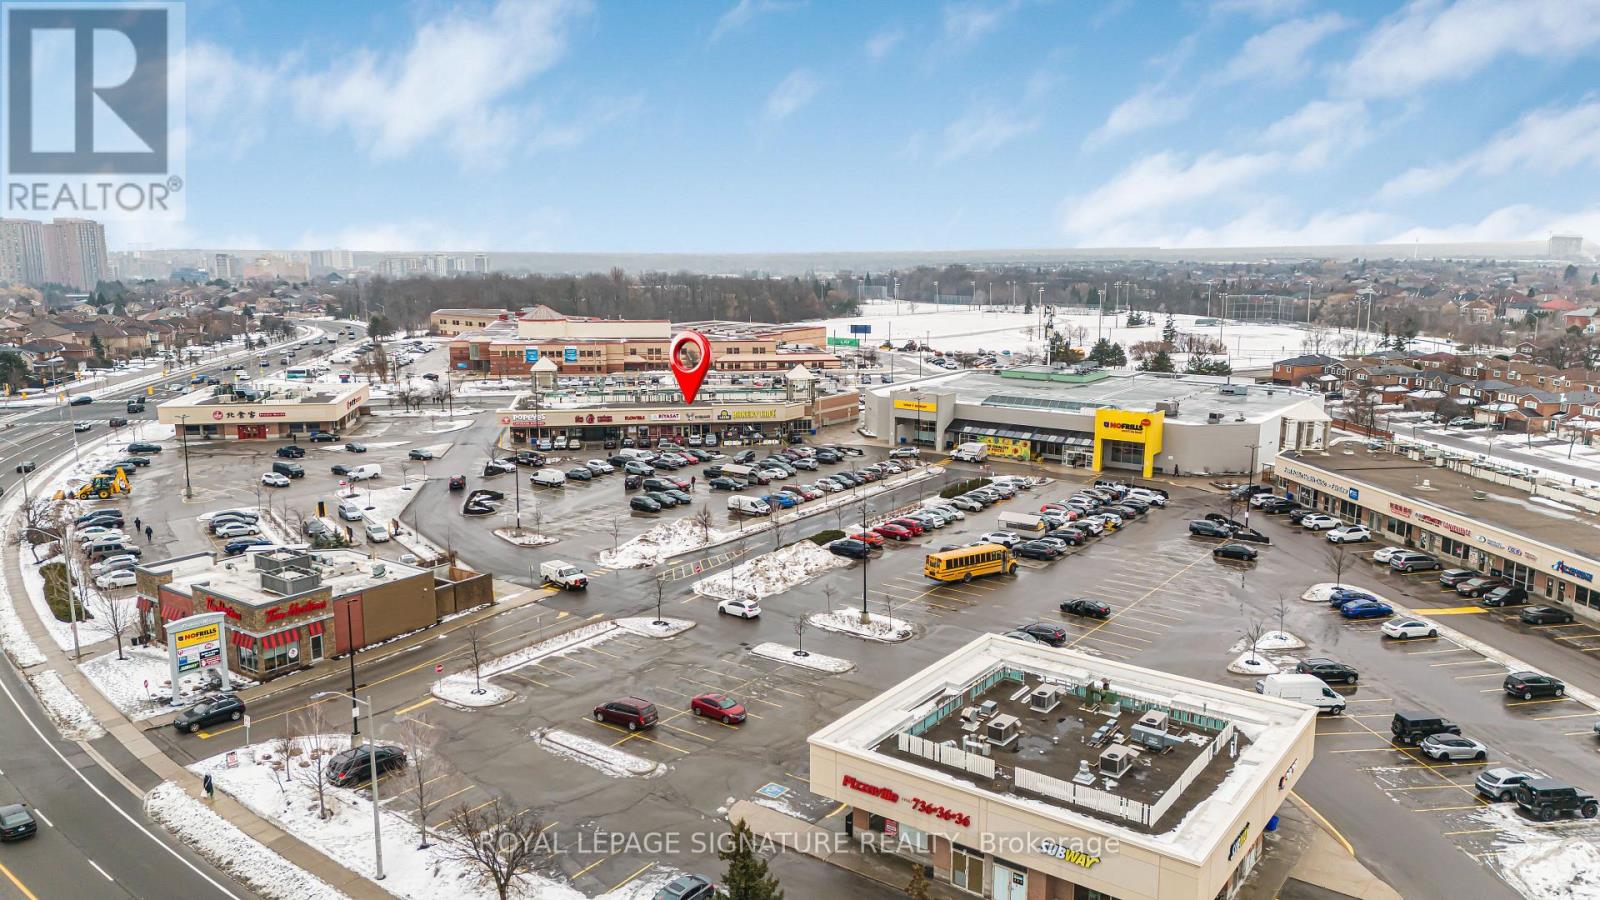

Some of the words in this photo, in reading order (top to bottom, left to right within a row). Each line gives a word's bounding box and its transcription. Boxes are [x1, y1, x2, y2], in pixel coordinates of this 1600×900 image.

[513, 413, 546, 421] POPEYES
[265, 607, 287, 624] Tim
[287, 599, 328, 616] Hortons
[842, 774, 900, 803] Pizzaville
[1040, 841, 1101, 869] SUBWAY
